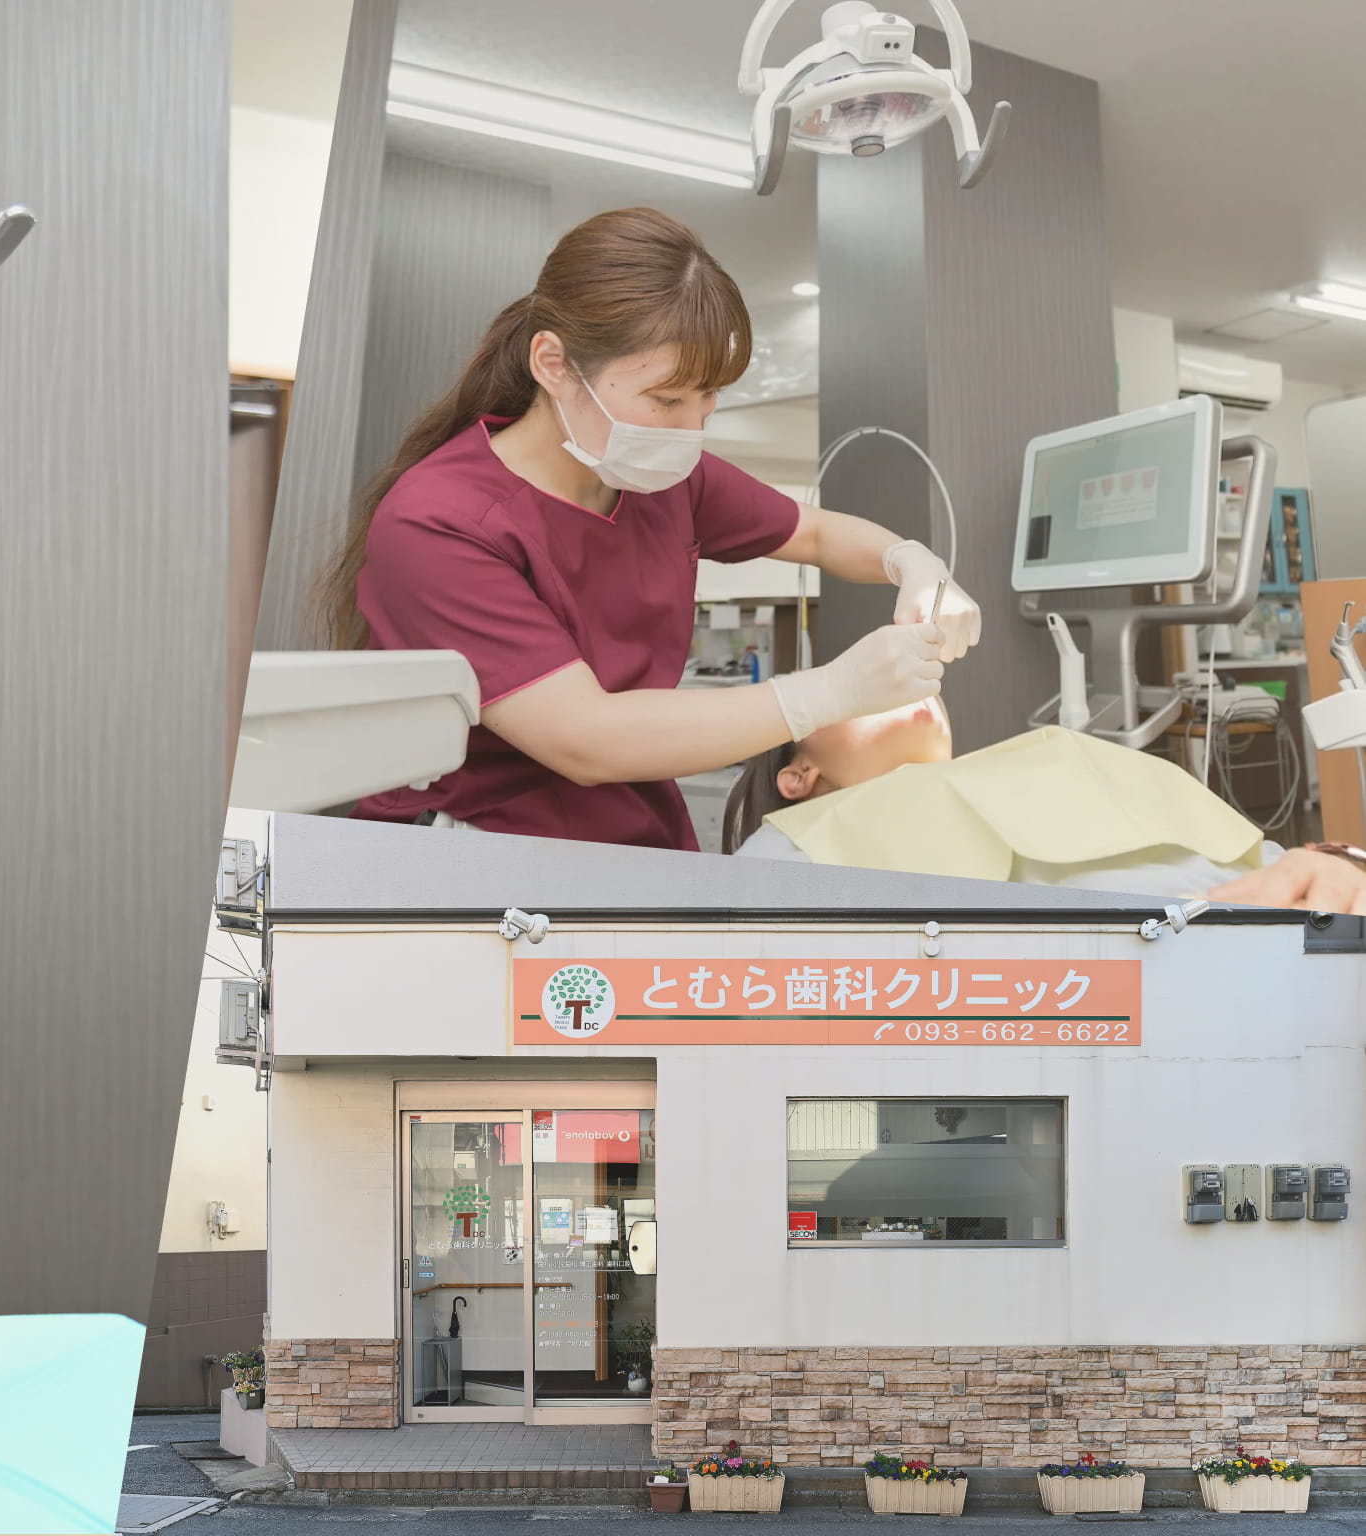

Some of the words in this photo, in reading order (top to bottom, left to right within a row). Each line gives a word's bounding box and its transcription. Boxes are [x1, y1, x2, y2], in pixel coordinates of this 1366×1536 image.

[643, 966, 1091, 1012] とむら歯科クリニック
[584, 1022, 599, 1030] DC
[905, 1022, 1129, 1041] 093-662-6622
